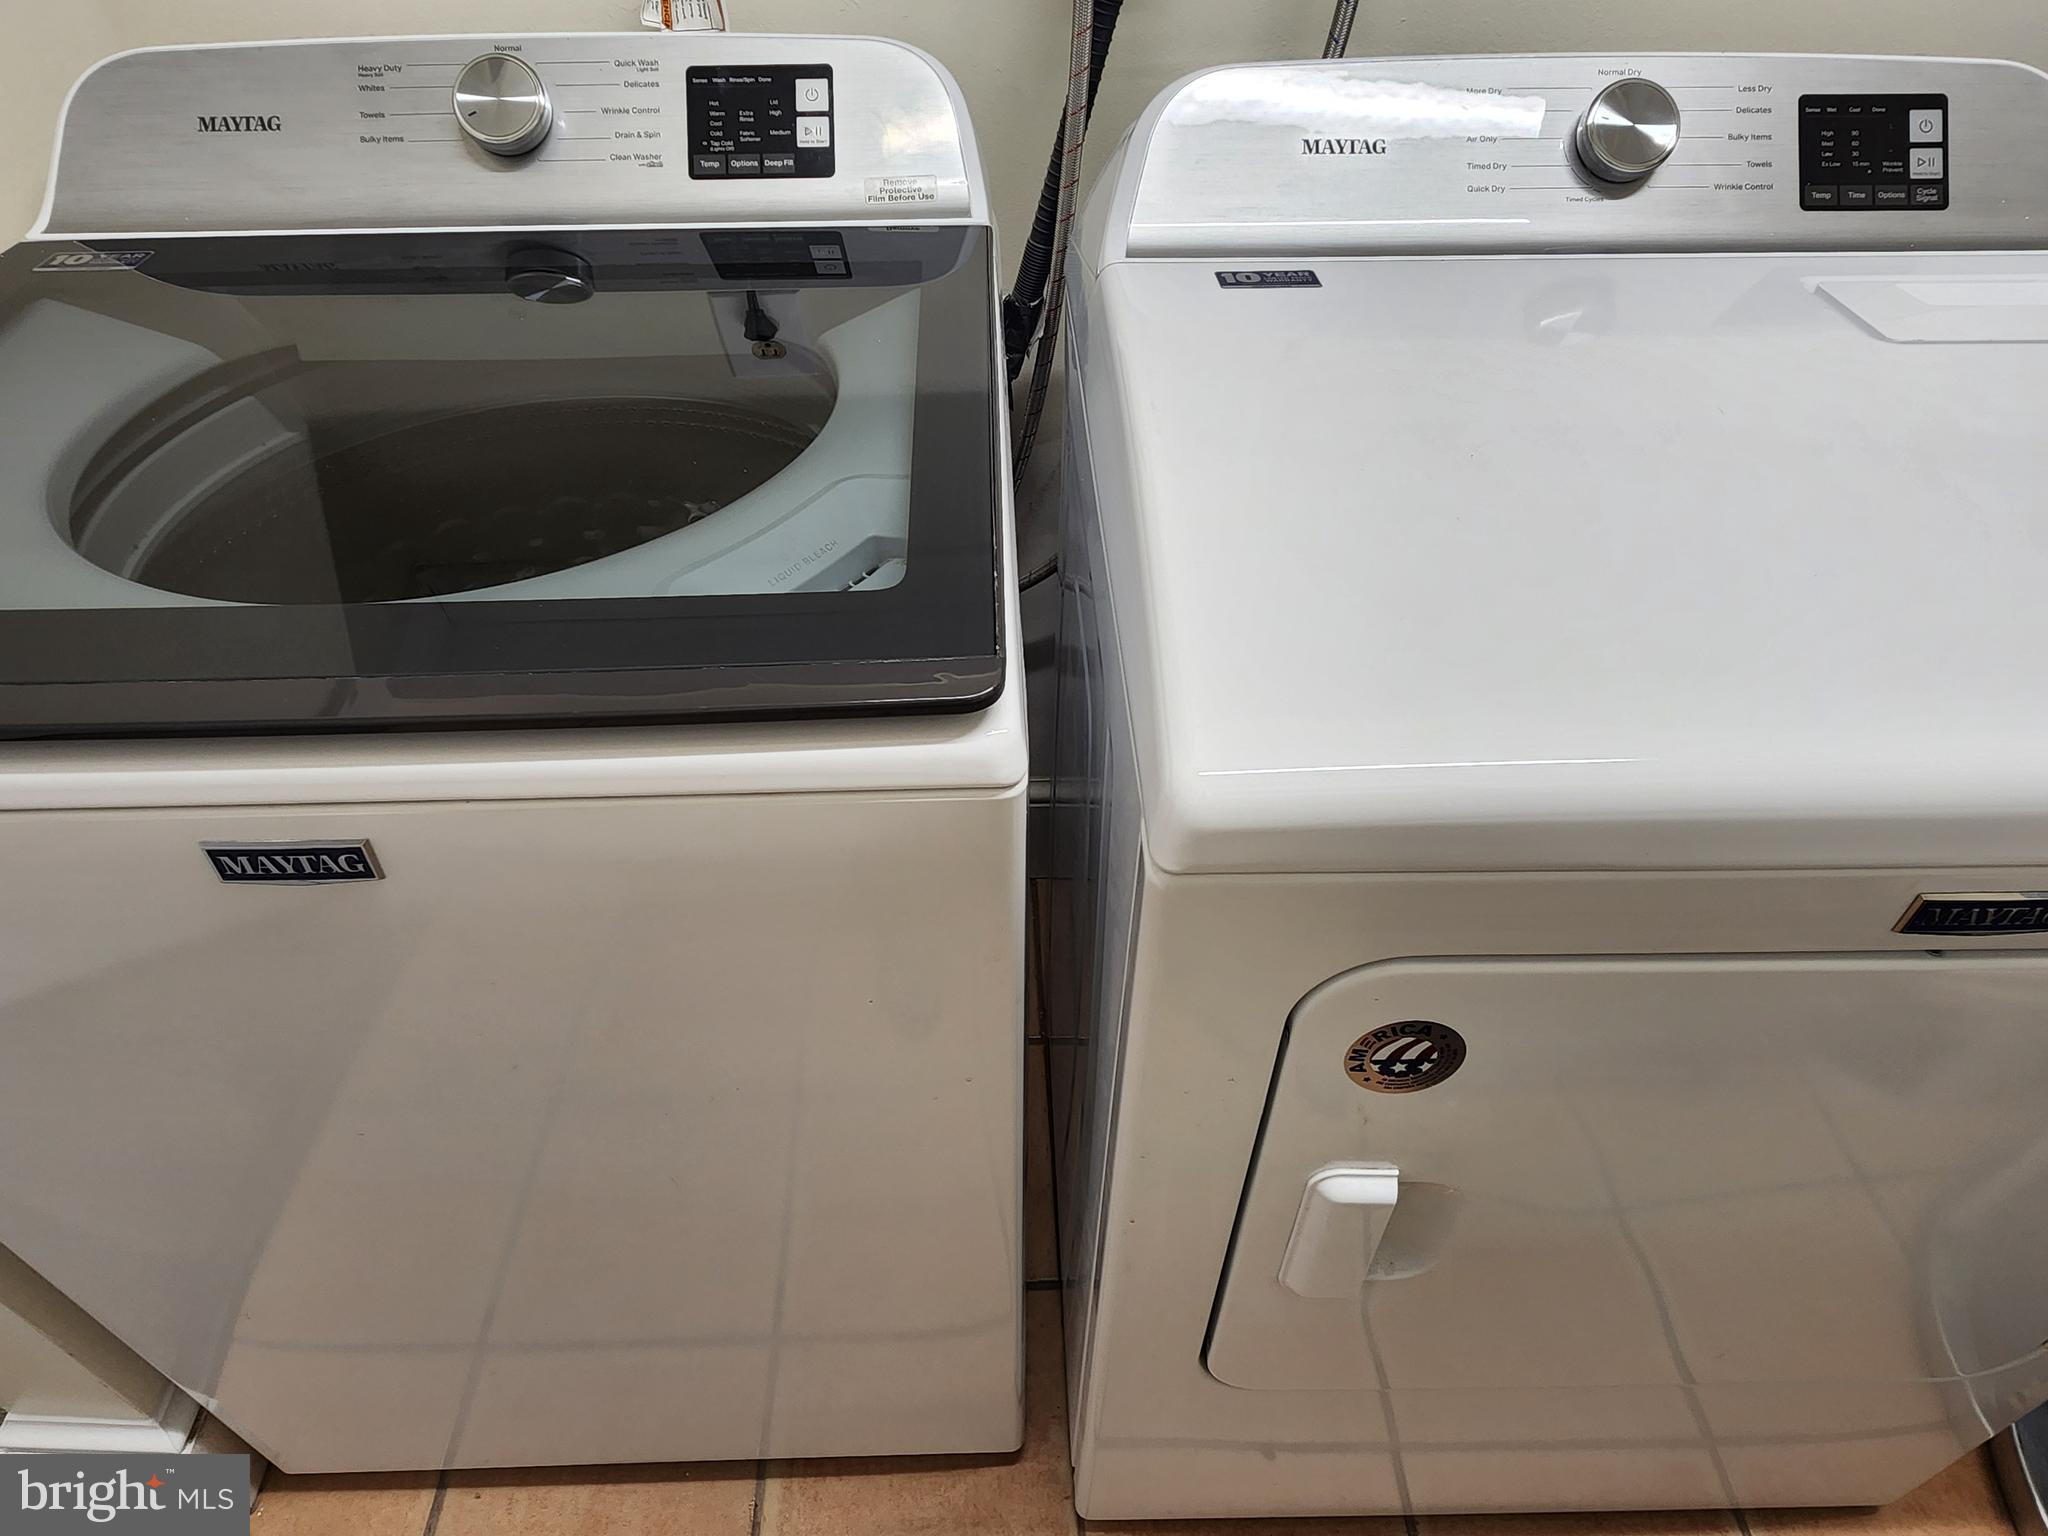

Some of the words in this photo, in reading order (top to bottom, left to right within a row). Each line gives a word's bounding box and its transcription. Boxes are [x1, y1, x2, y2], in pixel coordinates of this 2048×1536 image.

[494, 44, 522, 52] Normal
[613, 59, 637, 68] Quick
[637, 58, 659, 67] Wash
[357, 64, 383, 73] Heavy
[383, 64, 402, 73] Duty
[1597, 68, 1627, 76] Normal
[1627, 68, 1642, 77] Dry
[358, 84, 385, 92] Whites
[623, 80, 660, 88] Delicates
[1488, 87, 1503, 96] Dry
[1737, 84, 1757, 93] Less
[1757, 84, 1773, 94] Dry
[600, 106, 630, 115] Wrinkle
[631, 106, 661, 114] Control
[1735, 106, 1772, 114] Delicates
[359, 111, 386, 119] Towels
[197, 115, 282, 132] MAYTAG
[614, 131, 635, 139] Drain
[636, 131, 642, 139] &
[643, 130, 661, 139] Spin
[1727, 133, 1750, 142] Bulky
[360, 135, 382, 145] Bulky
[382, 135, 405, 143] Items
[1465, 135, 1478, 143] Air
[1479, 135, 1498, 144] Only
[1301, 138, 1388, 155] MAYTAG
[609, 153, 632, 161] Clean
[632, 152, 663, 161] Washer
[700, 160, 720, 168] Temp
[730, 160, 759, 168] Options
[764, 159, 783, 168] Deep
[1466, 162, 1492, 170] Timed
[1492, 162, 1507, 171] Dry
[1746, 160, 1773, 168] Towels
[882, 178, 919, 187] Remove
[1713, 183, 1743, 191] Wrinkle
[1744, 183, 1774, 191] Control
[879, 186, 923, 195] Protective
[1467, 184, 1490, 193] Quick
[1491, 184, 1506, 194] Dry
[1916, 187, 1937, 195] Cycle
[867, 195, 886, 203] Film
[887, 194, 916, 202] Before
[918, 192, 935, 200] Use
[1811, 191, 1831, 199] Temp
[1877, 191, 1906, 199] Options
[49, 254, 94, 265] 10
[1221, 272, 1261, 284] 10
[768, 563, 802, 587] LIQUID
[801, 539, 839, 567] BLEACH
[217, 854, 365, 875] MAYTAG
[1348, 1024, 1432, 1073] AMERICA
